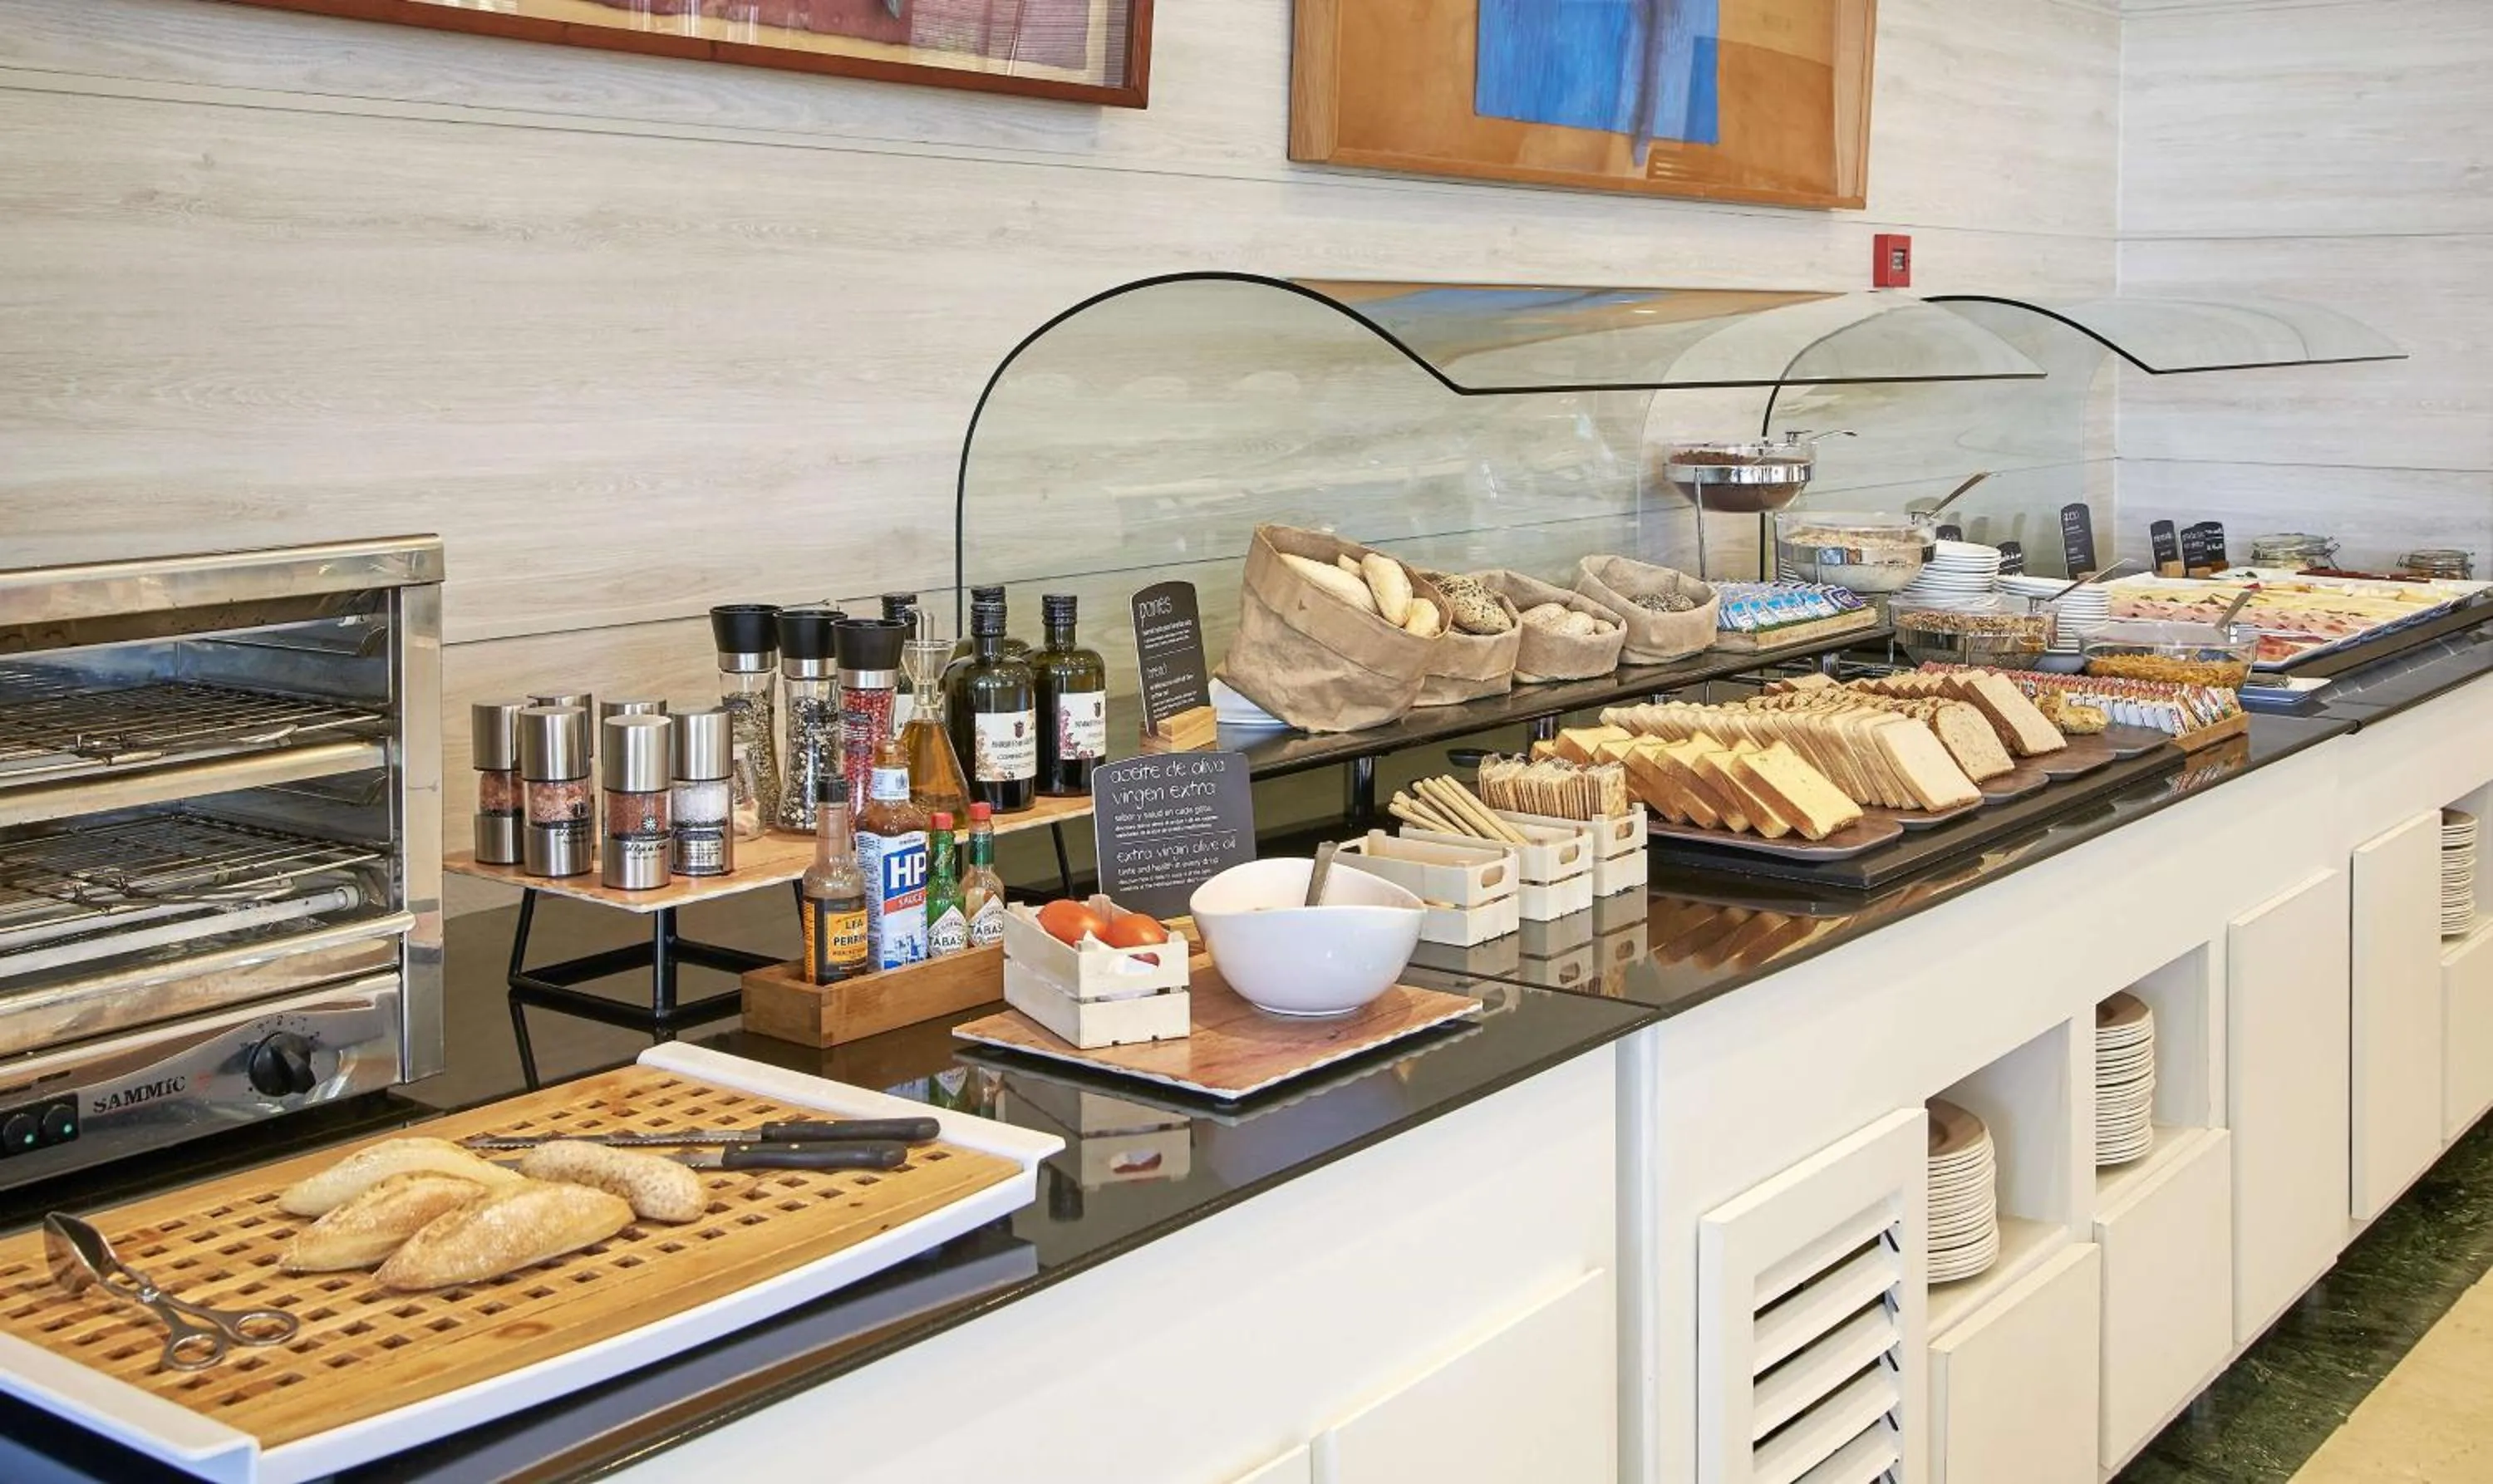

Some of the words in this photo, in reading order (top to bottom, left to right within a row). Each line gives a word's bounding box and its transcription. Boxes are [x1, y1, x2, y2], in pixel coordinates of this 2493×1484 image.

[1110, 764, 1161, 784] aceite
[1166, 760, 1187, 777] de
[1191, 757, 1225, 775] oliva
[1112, 787, 1164, 810] virgen
[1169, 780, 1217, 799] extra
[1116, 848, 1153, 863] extra
[1157, 840, 1189, 861] virgin
[1192, 839, 1220, 854] olive
[1222, 836, 1237, 850] oil
[890, 853, 927, 888] HP
[845, 918, 863, 930] LEA
[93, 1076, 185, 1113] SAMMIC
